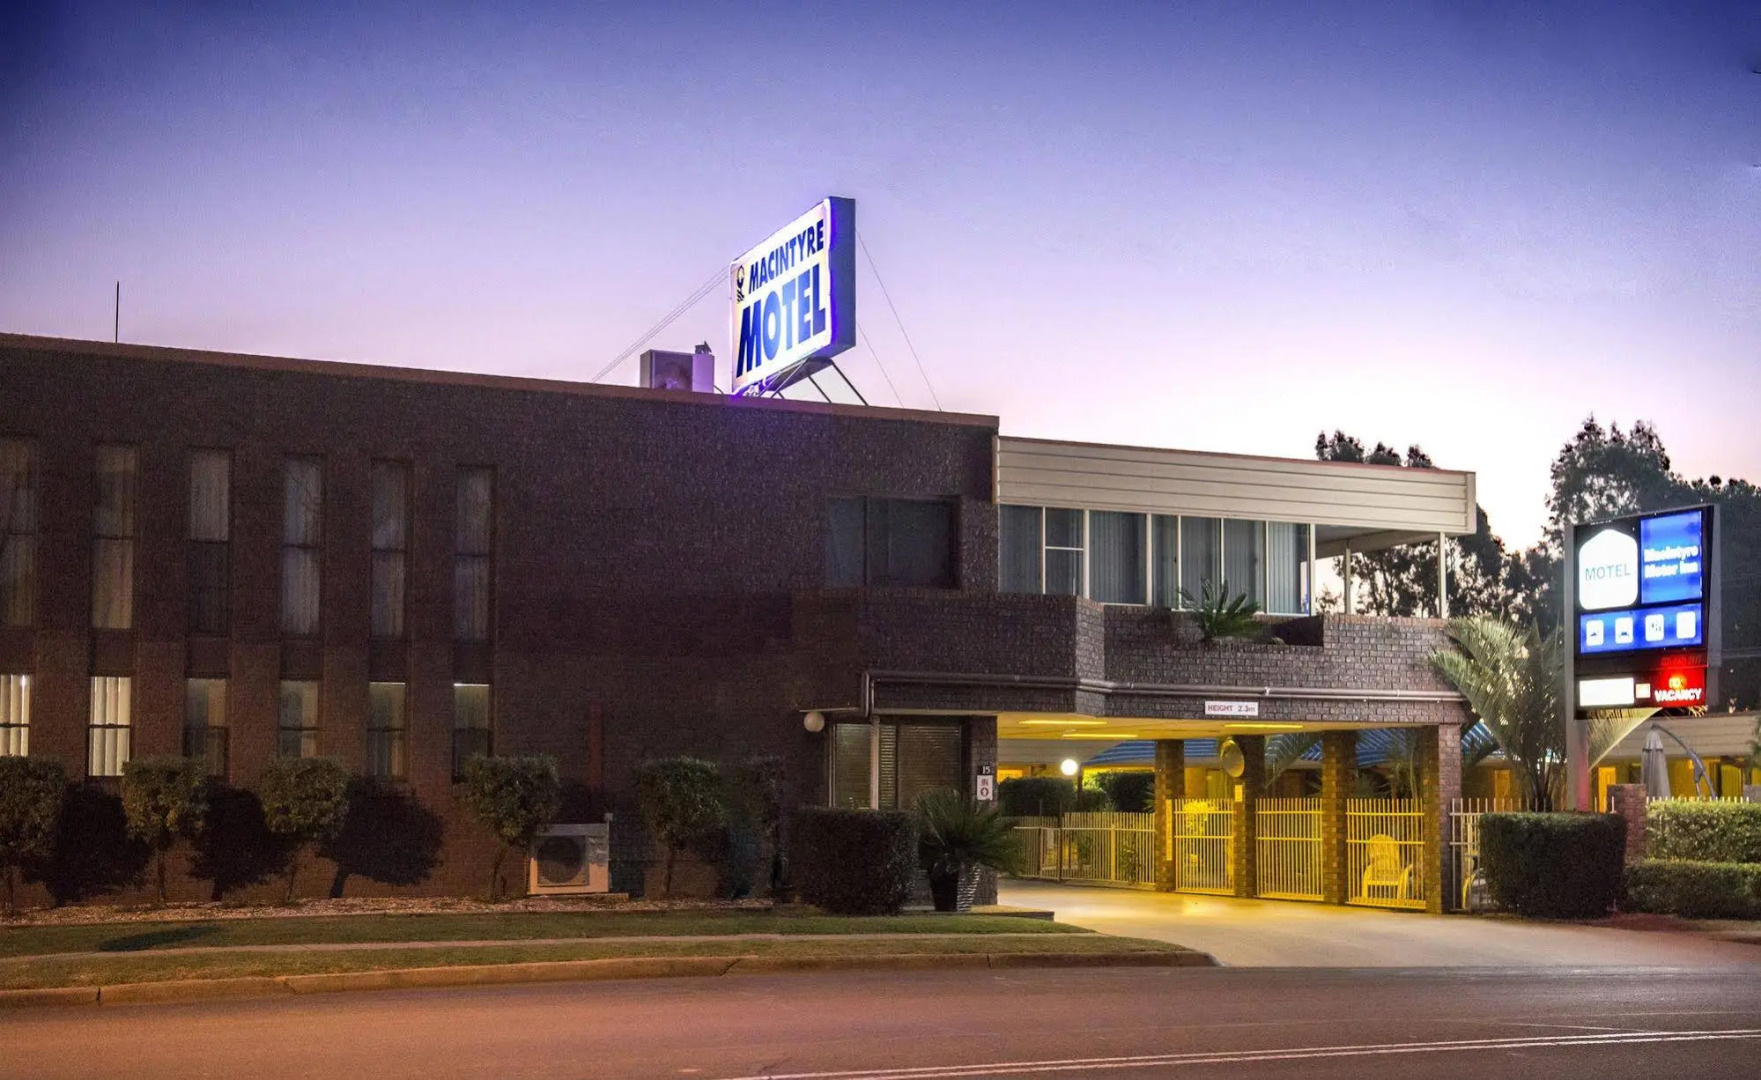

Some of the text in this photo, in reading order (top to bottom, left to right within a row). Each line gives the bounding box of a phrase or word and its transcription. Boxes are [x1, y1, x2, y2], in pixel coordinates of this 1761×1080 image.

[749, 219, 824, 294] MACINTYRE
[736, 263, 826, 378] MOTEL
[1585, 564, 1631, 581] MOTEL
[1654, 688, 1702, 702] VACANCY
[982, 766, 990, 774] 15
